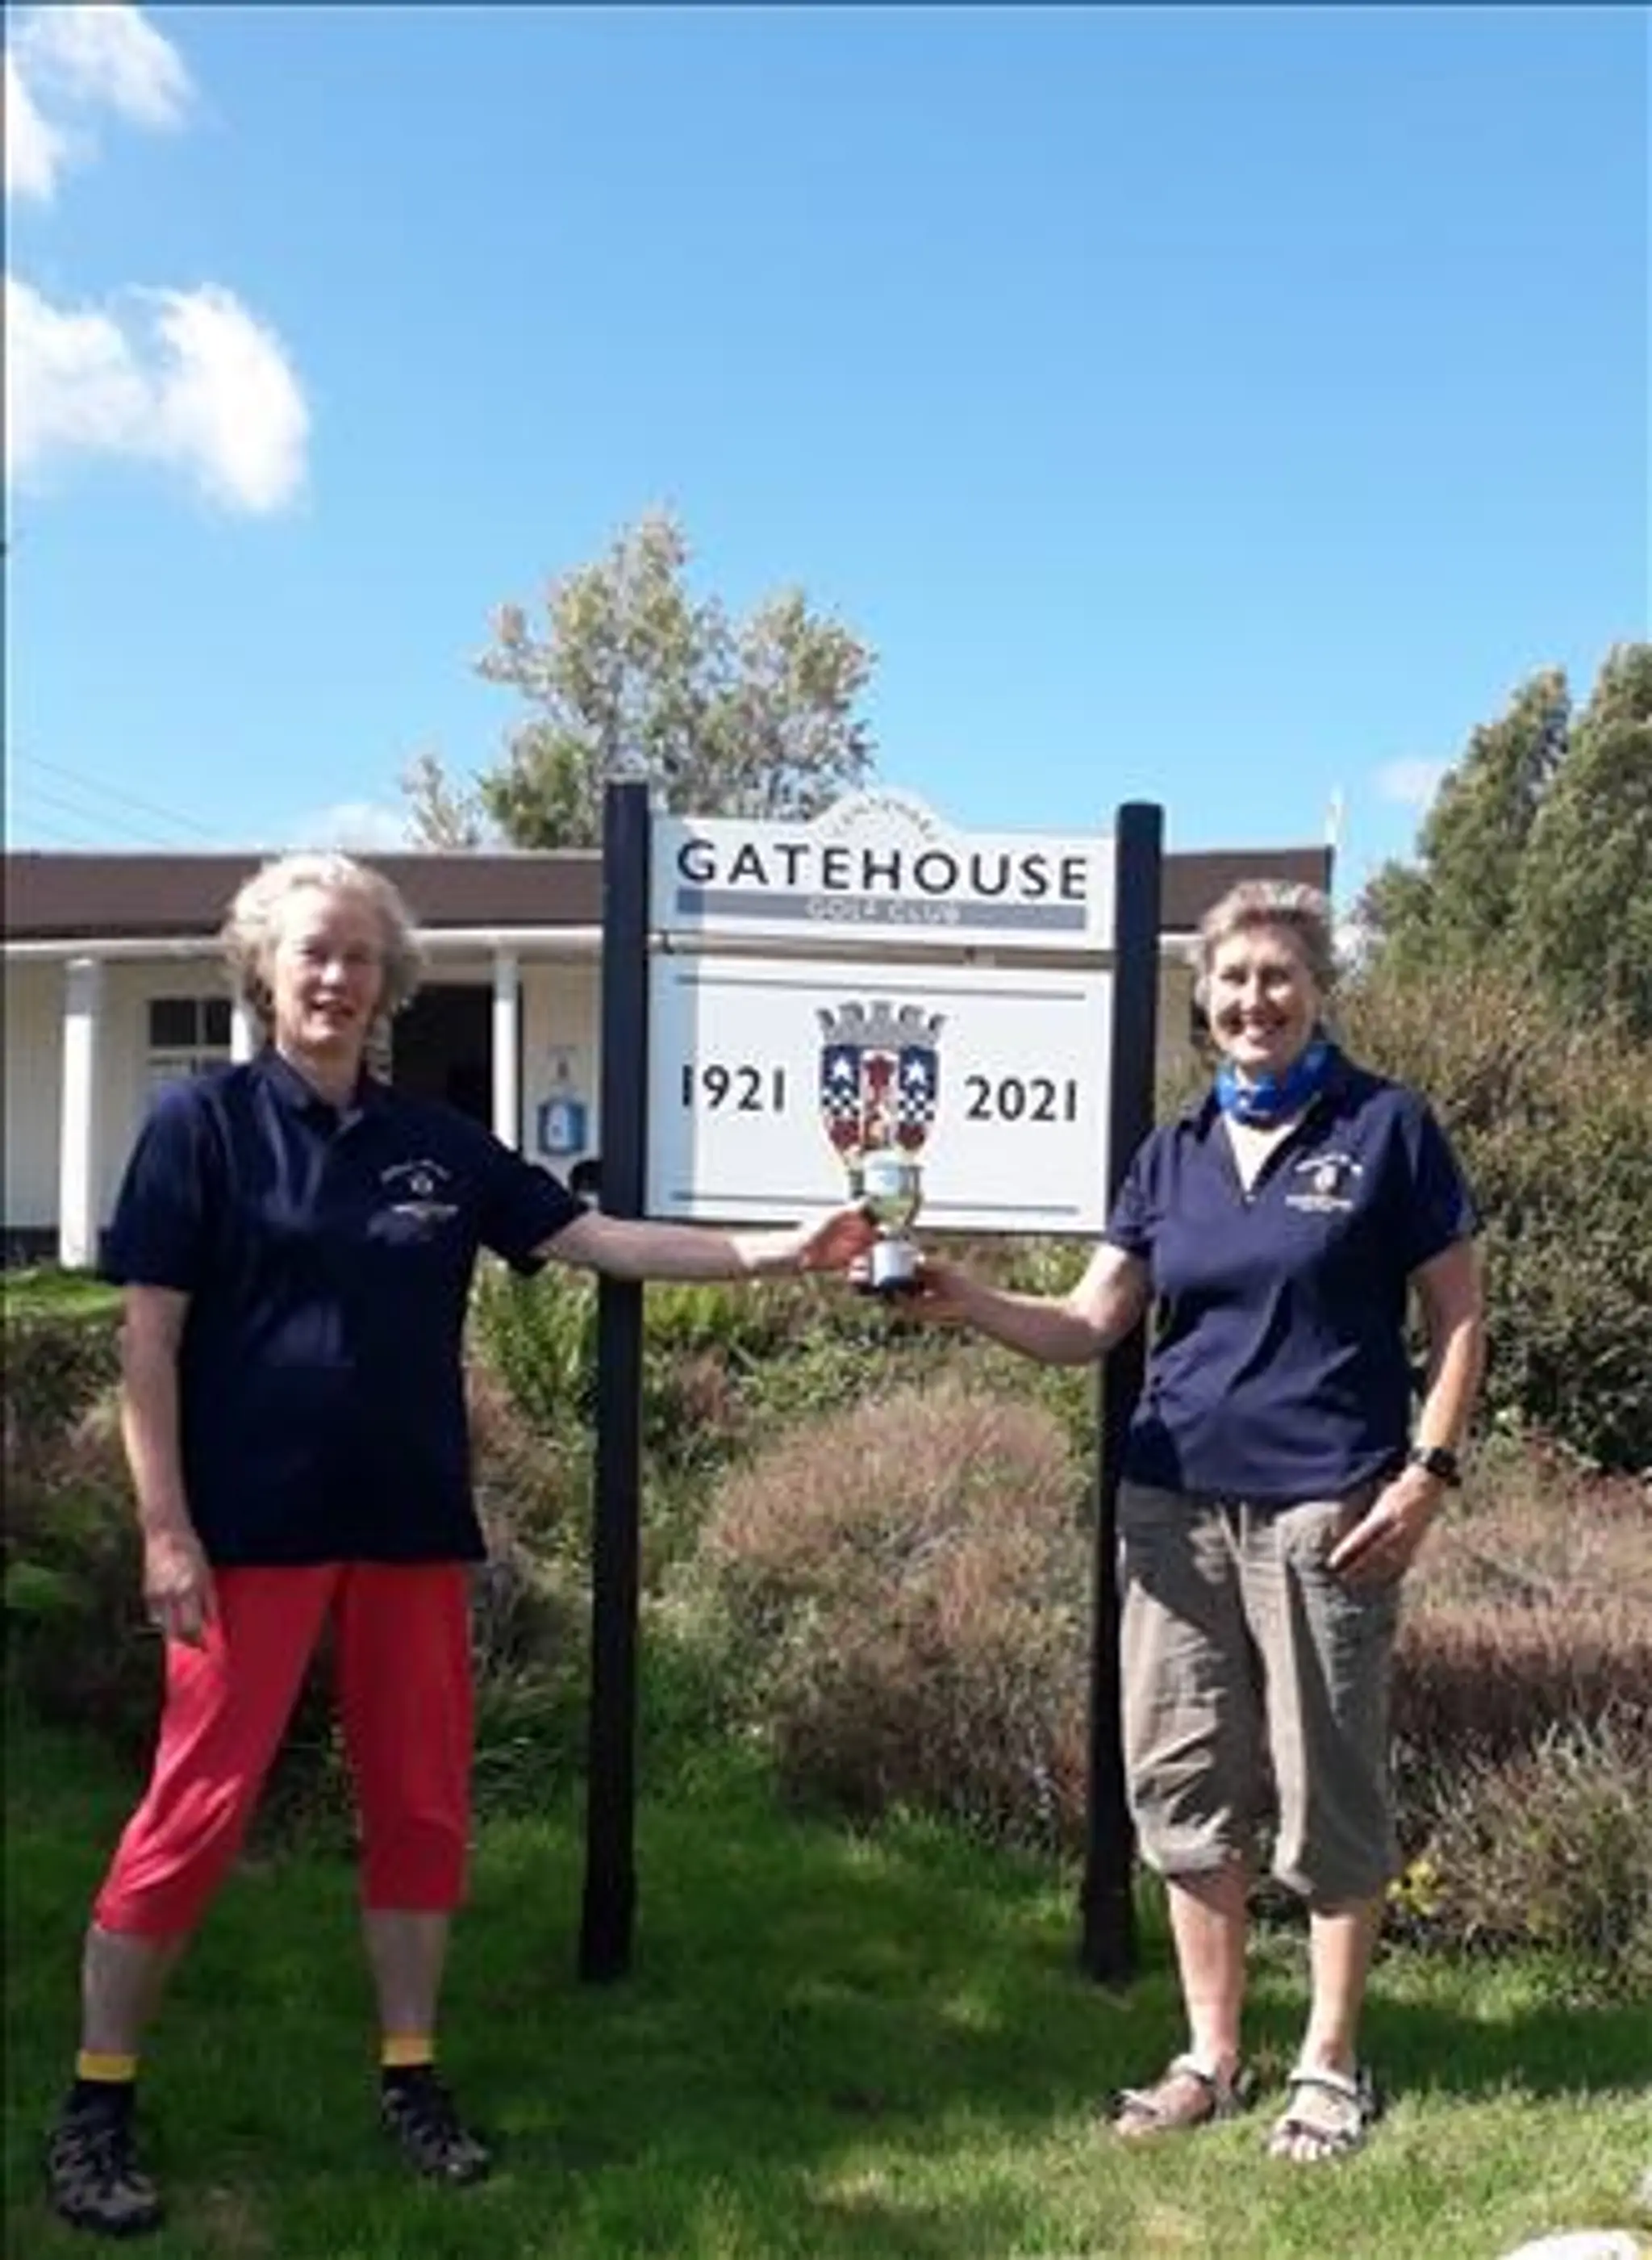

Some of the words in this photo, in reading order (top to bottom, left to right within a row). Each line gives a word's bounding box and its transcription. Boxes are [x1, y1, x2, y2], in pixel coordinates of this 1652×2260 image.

[677, 839, 1087, 900] GATEHOUSE
[806, 897, 876, 921] GOLF
[888, 902, 962, 925] CLUB
[682, 1064, 785, 1112] 1921
[965, 1076, 1077, 1122] 2021
